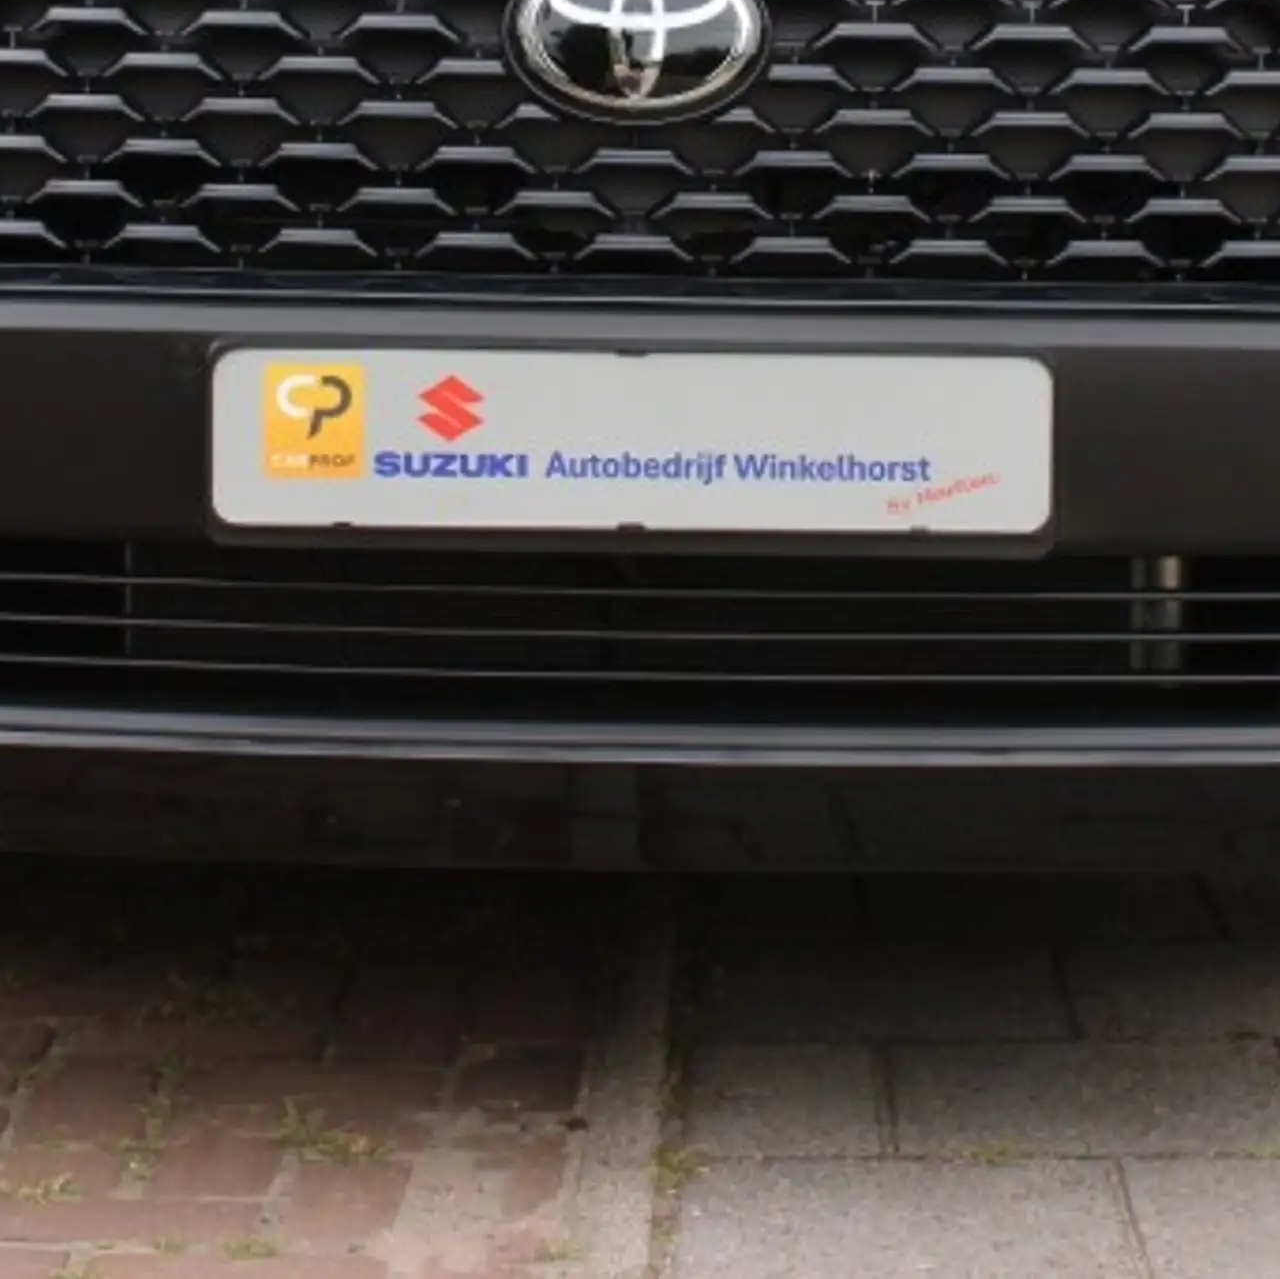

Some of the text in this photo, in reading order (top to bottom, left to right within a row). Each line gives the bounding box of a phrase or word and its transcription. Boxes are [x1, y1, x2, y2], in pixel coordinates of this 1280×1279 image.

[373, 449, 931, 486] SUZUKI Autobedrijf Winkelhorst
